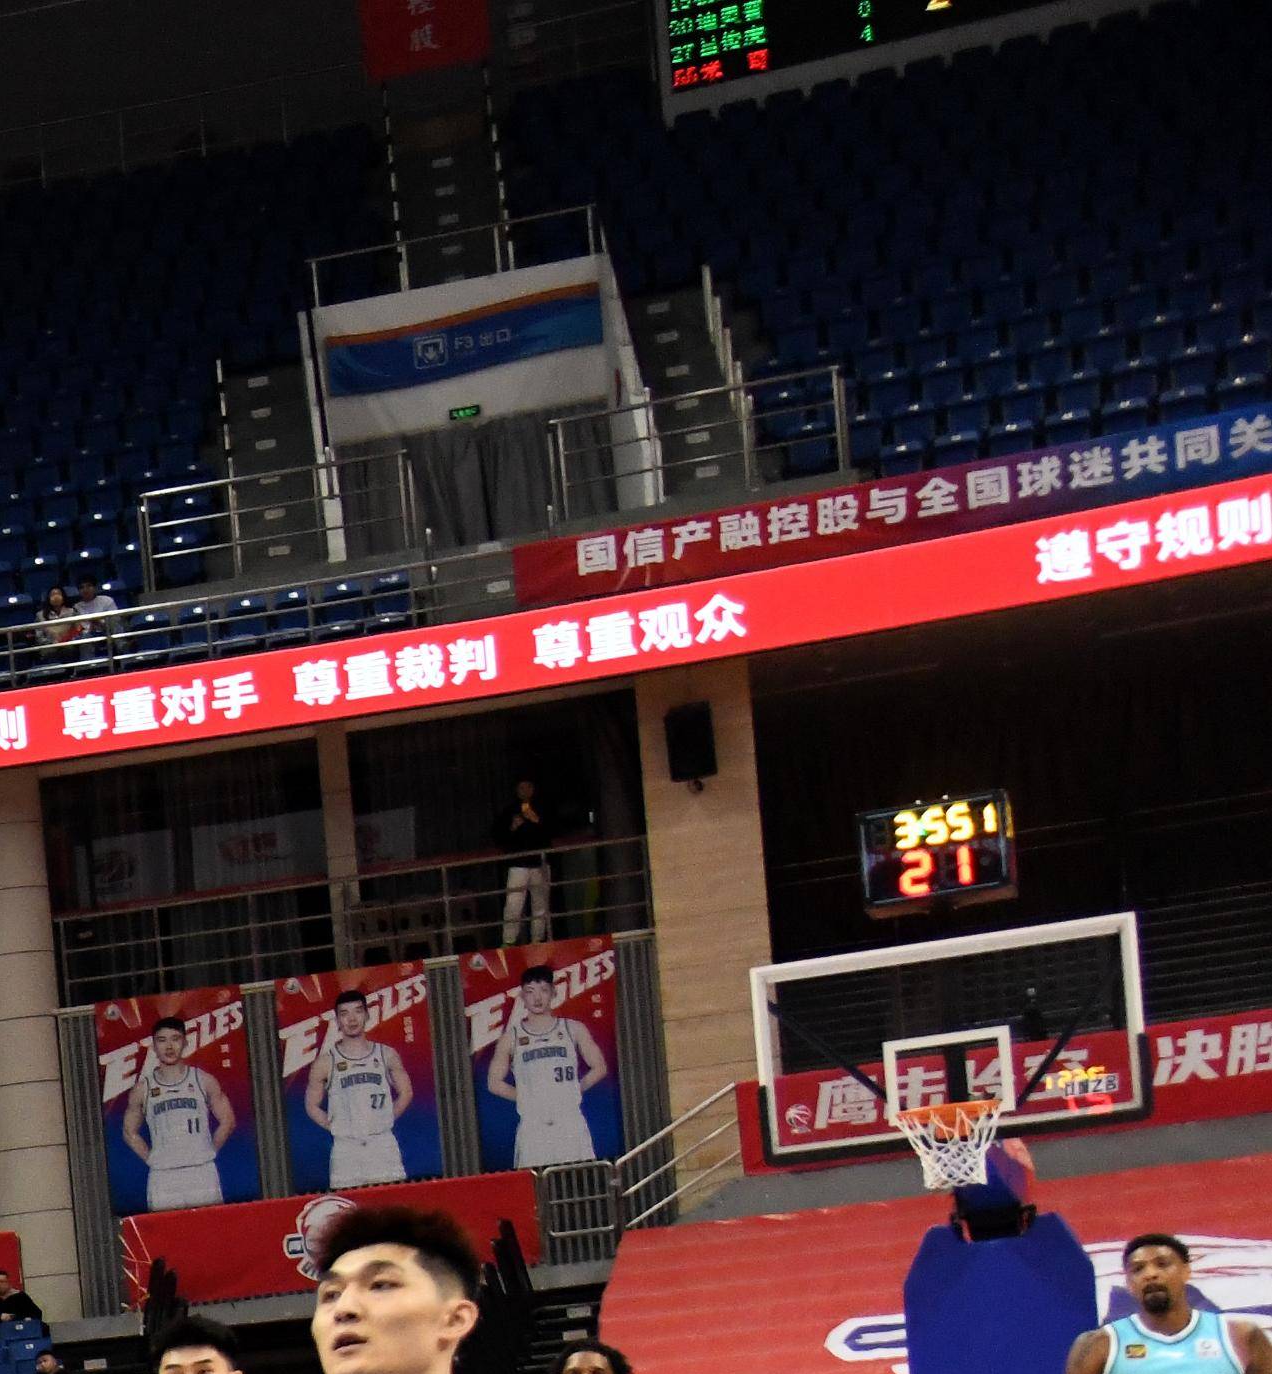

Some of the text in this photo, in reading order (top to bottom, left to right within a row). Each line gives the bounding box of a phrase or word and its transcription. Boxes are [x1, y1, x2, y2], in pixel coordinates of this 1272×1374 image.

[479, 329, 511, 347] 出口
[1035, 492, 1272, 585] 遵守规则
[61, 671, 259, 742] 尊重对手
[293, 634, 498, 707] 尊重裁判
[532, 593, 747, 670] 尊重观众
[899, 844, 975, 897] 21
[554, 1066, 575, 1083] 36
[370, 1093, 386, 1110] 27
[187, 1118, 200, 1134] 11
